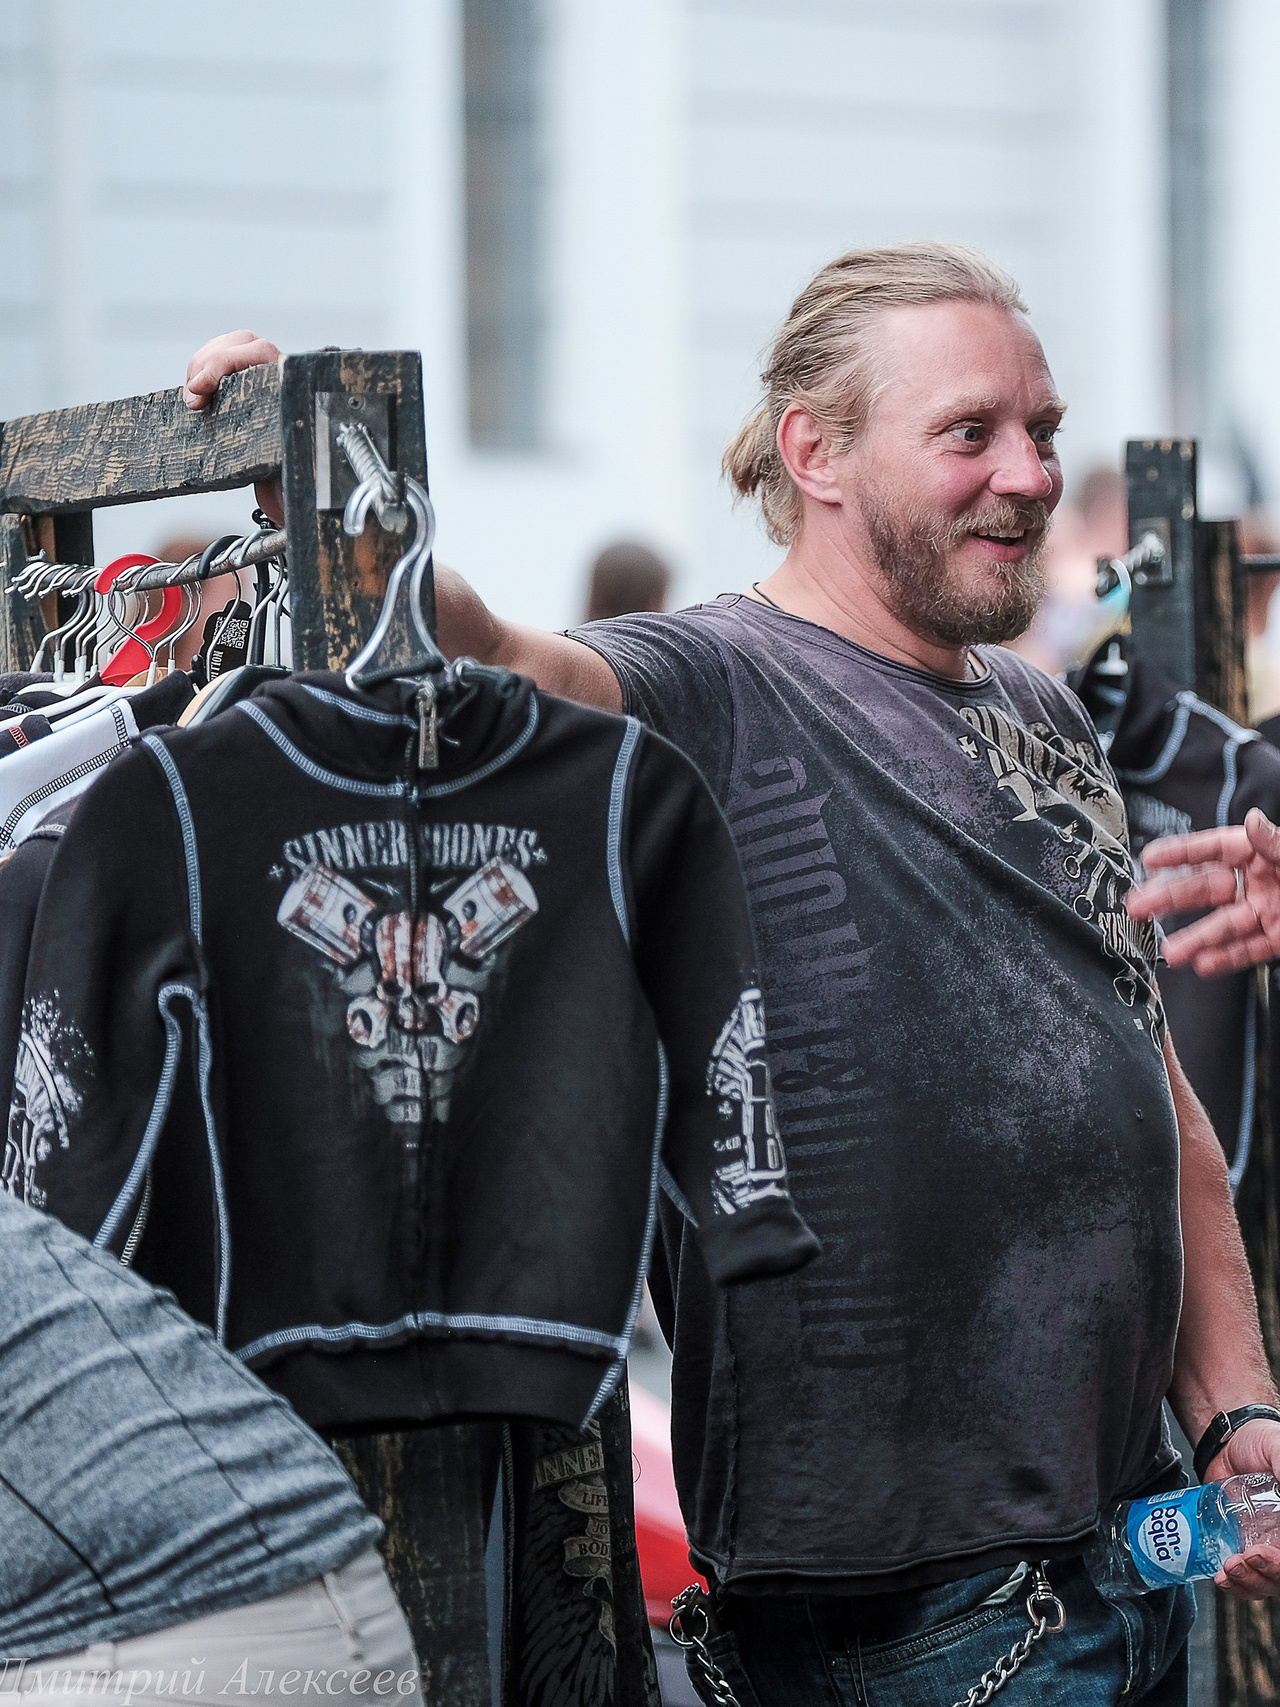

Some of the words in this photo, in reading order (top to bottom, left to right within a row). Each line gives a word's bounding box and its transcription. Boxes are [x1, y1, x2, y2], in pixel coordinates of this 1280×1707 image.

[283, 819, 409, 877] SINNER
[578, 1541, 609, 1557] BOD
[1147, 1506, 1174, 1562] aqua
